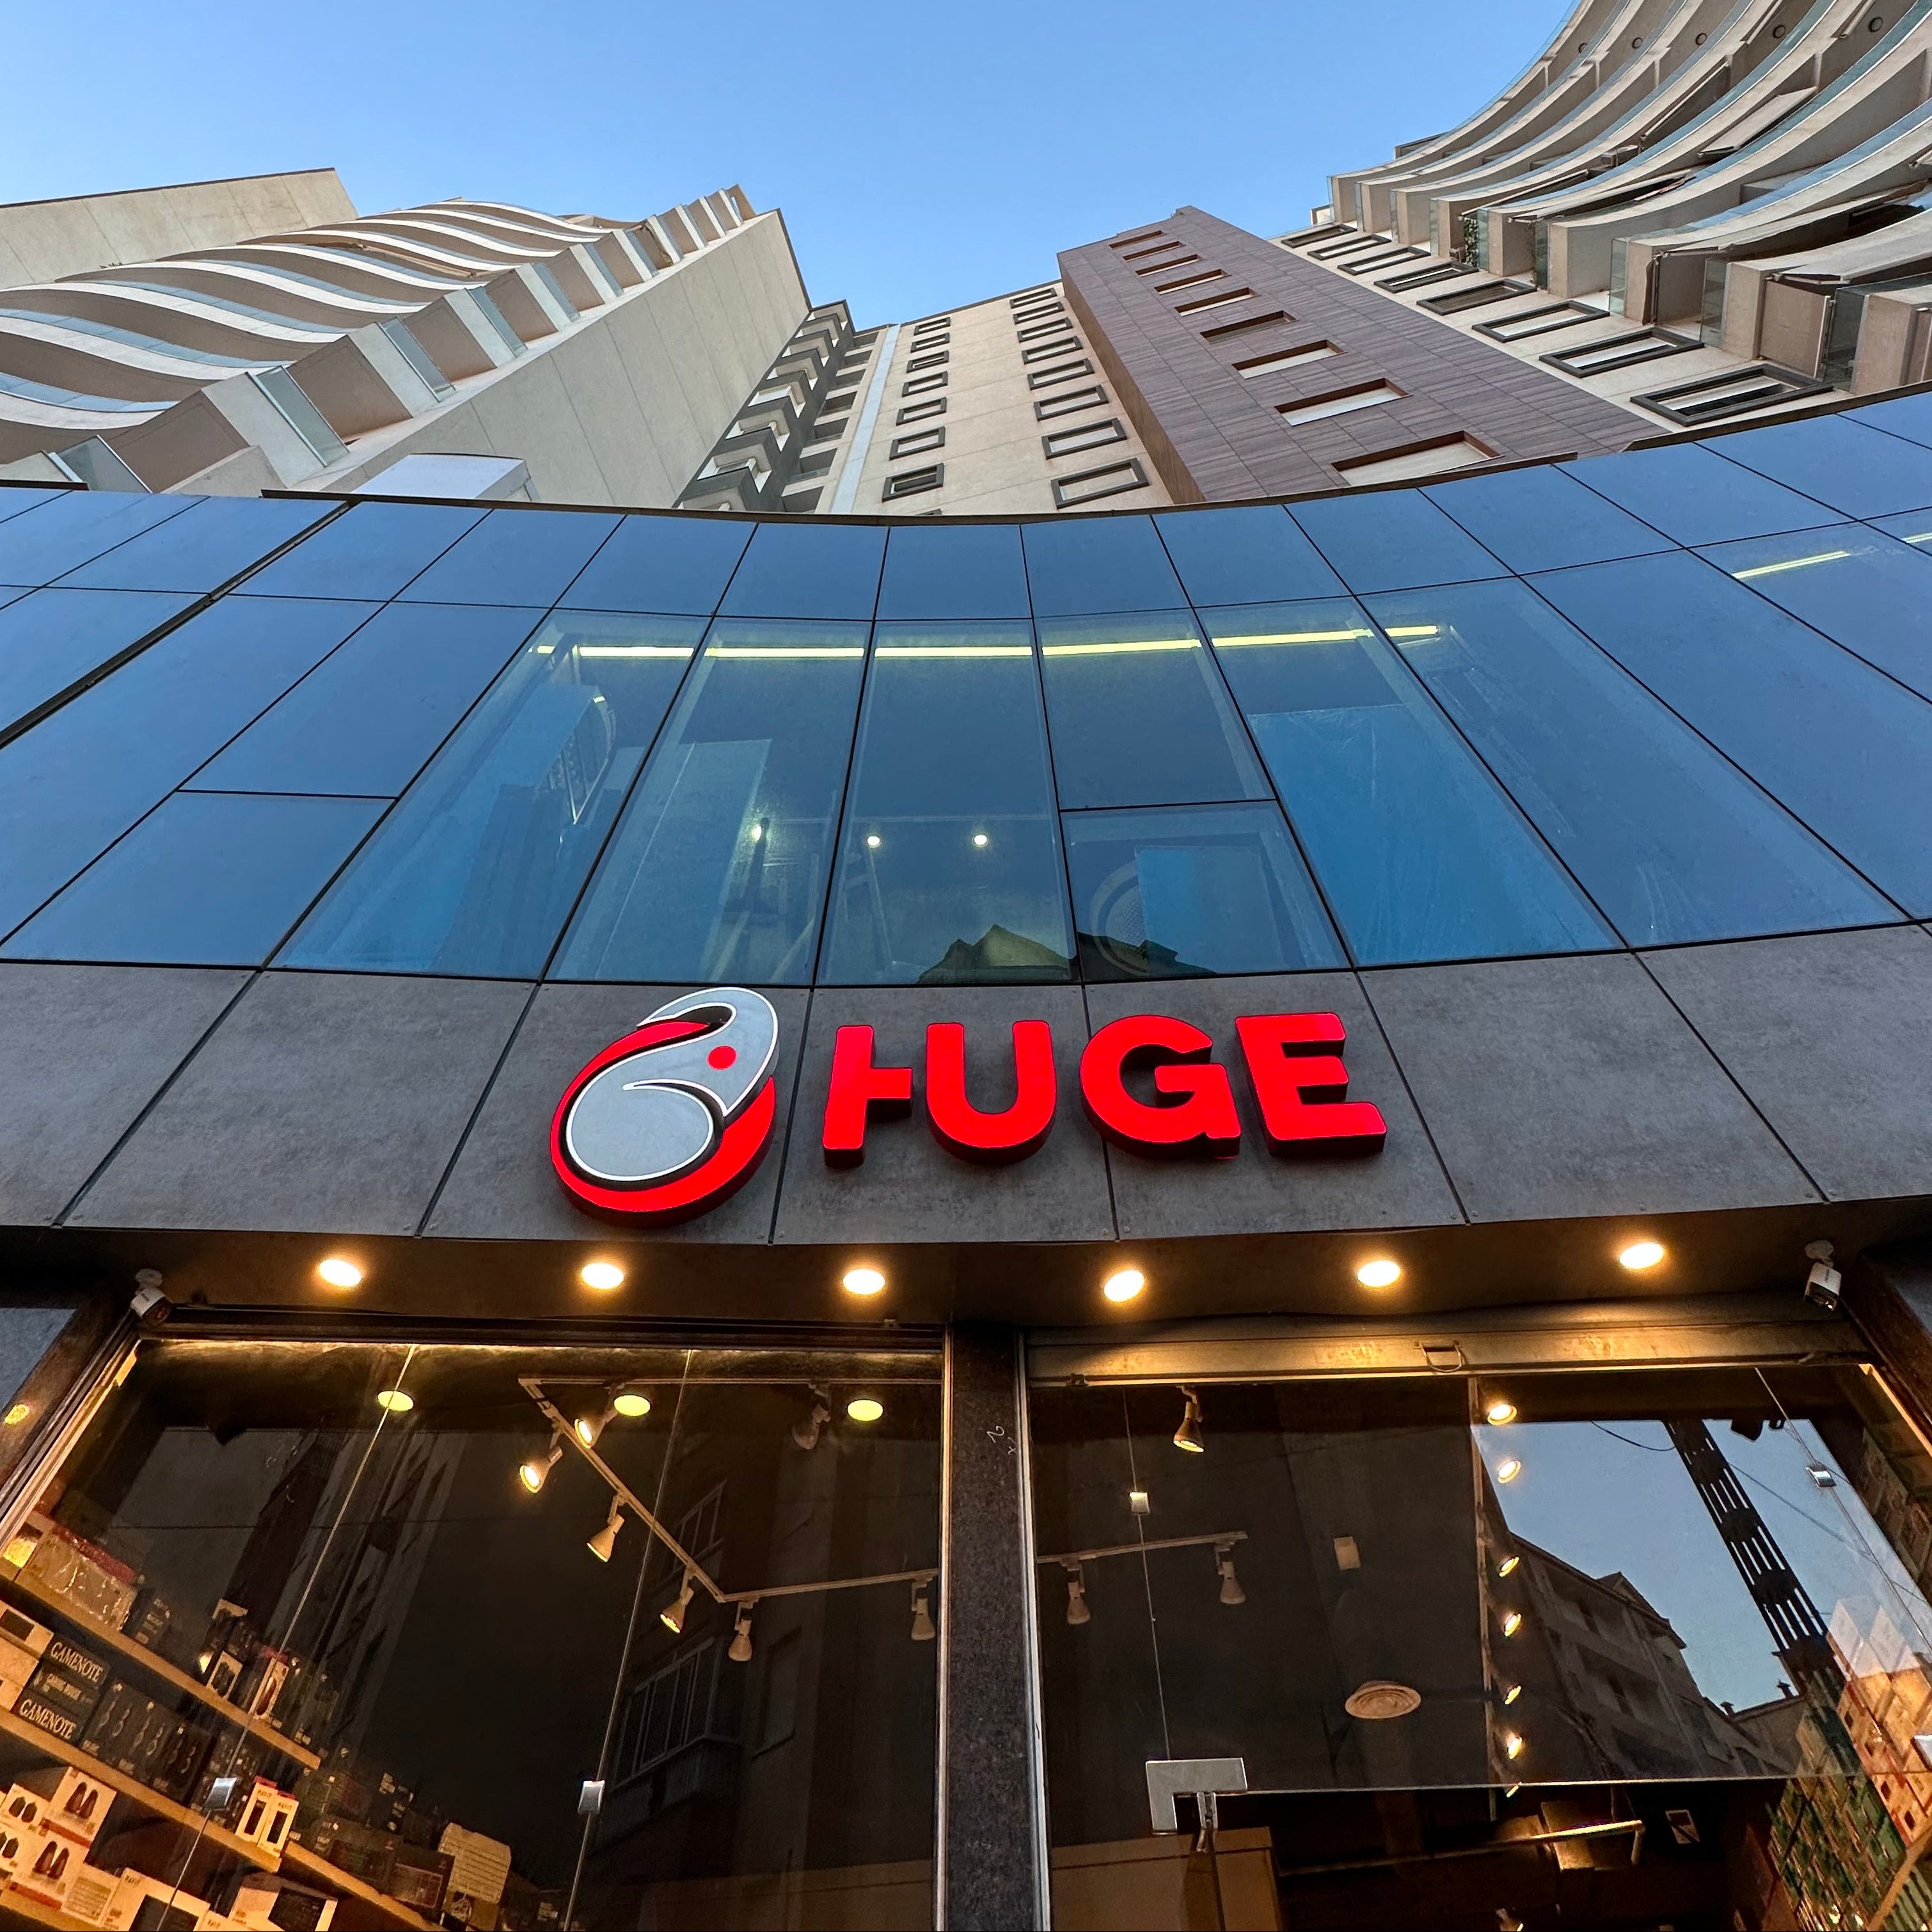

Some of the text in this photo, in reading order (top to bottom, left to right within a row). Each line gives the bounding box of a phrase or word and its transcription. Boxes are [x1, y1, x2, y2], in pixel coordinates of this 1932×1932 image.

[823, 1012, 1387, 1157] HUGE
[51, 1642, 104, 1683] GAMENOTE
[20, 1698, 77, 1740] GAMENOTE
